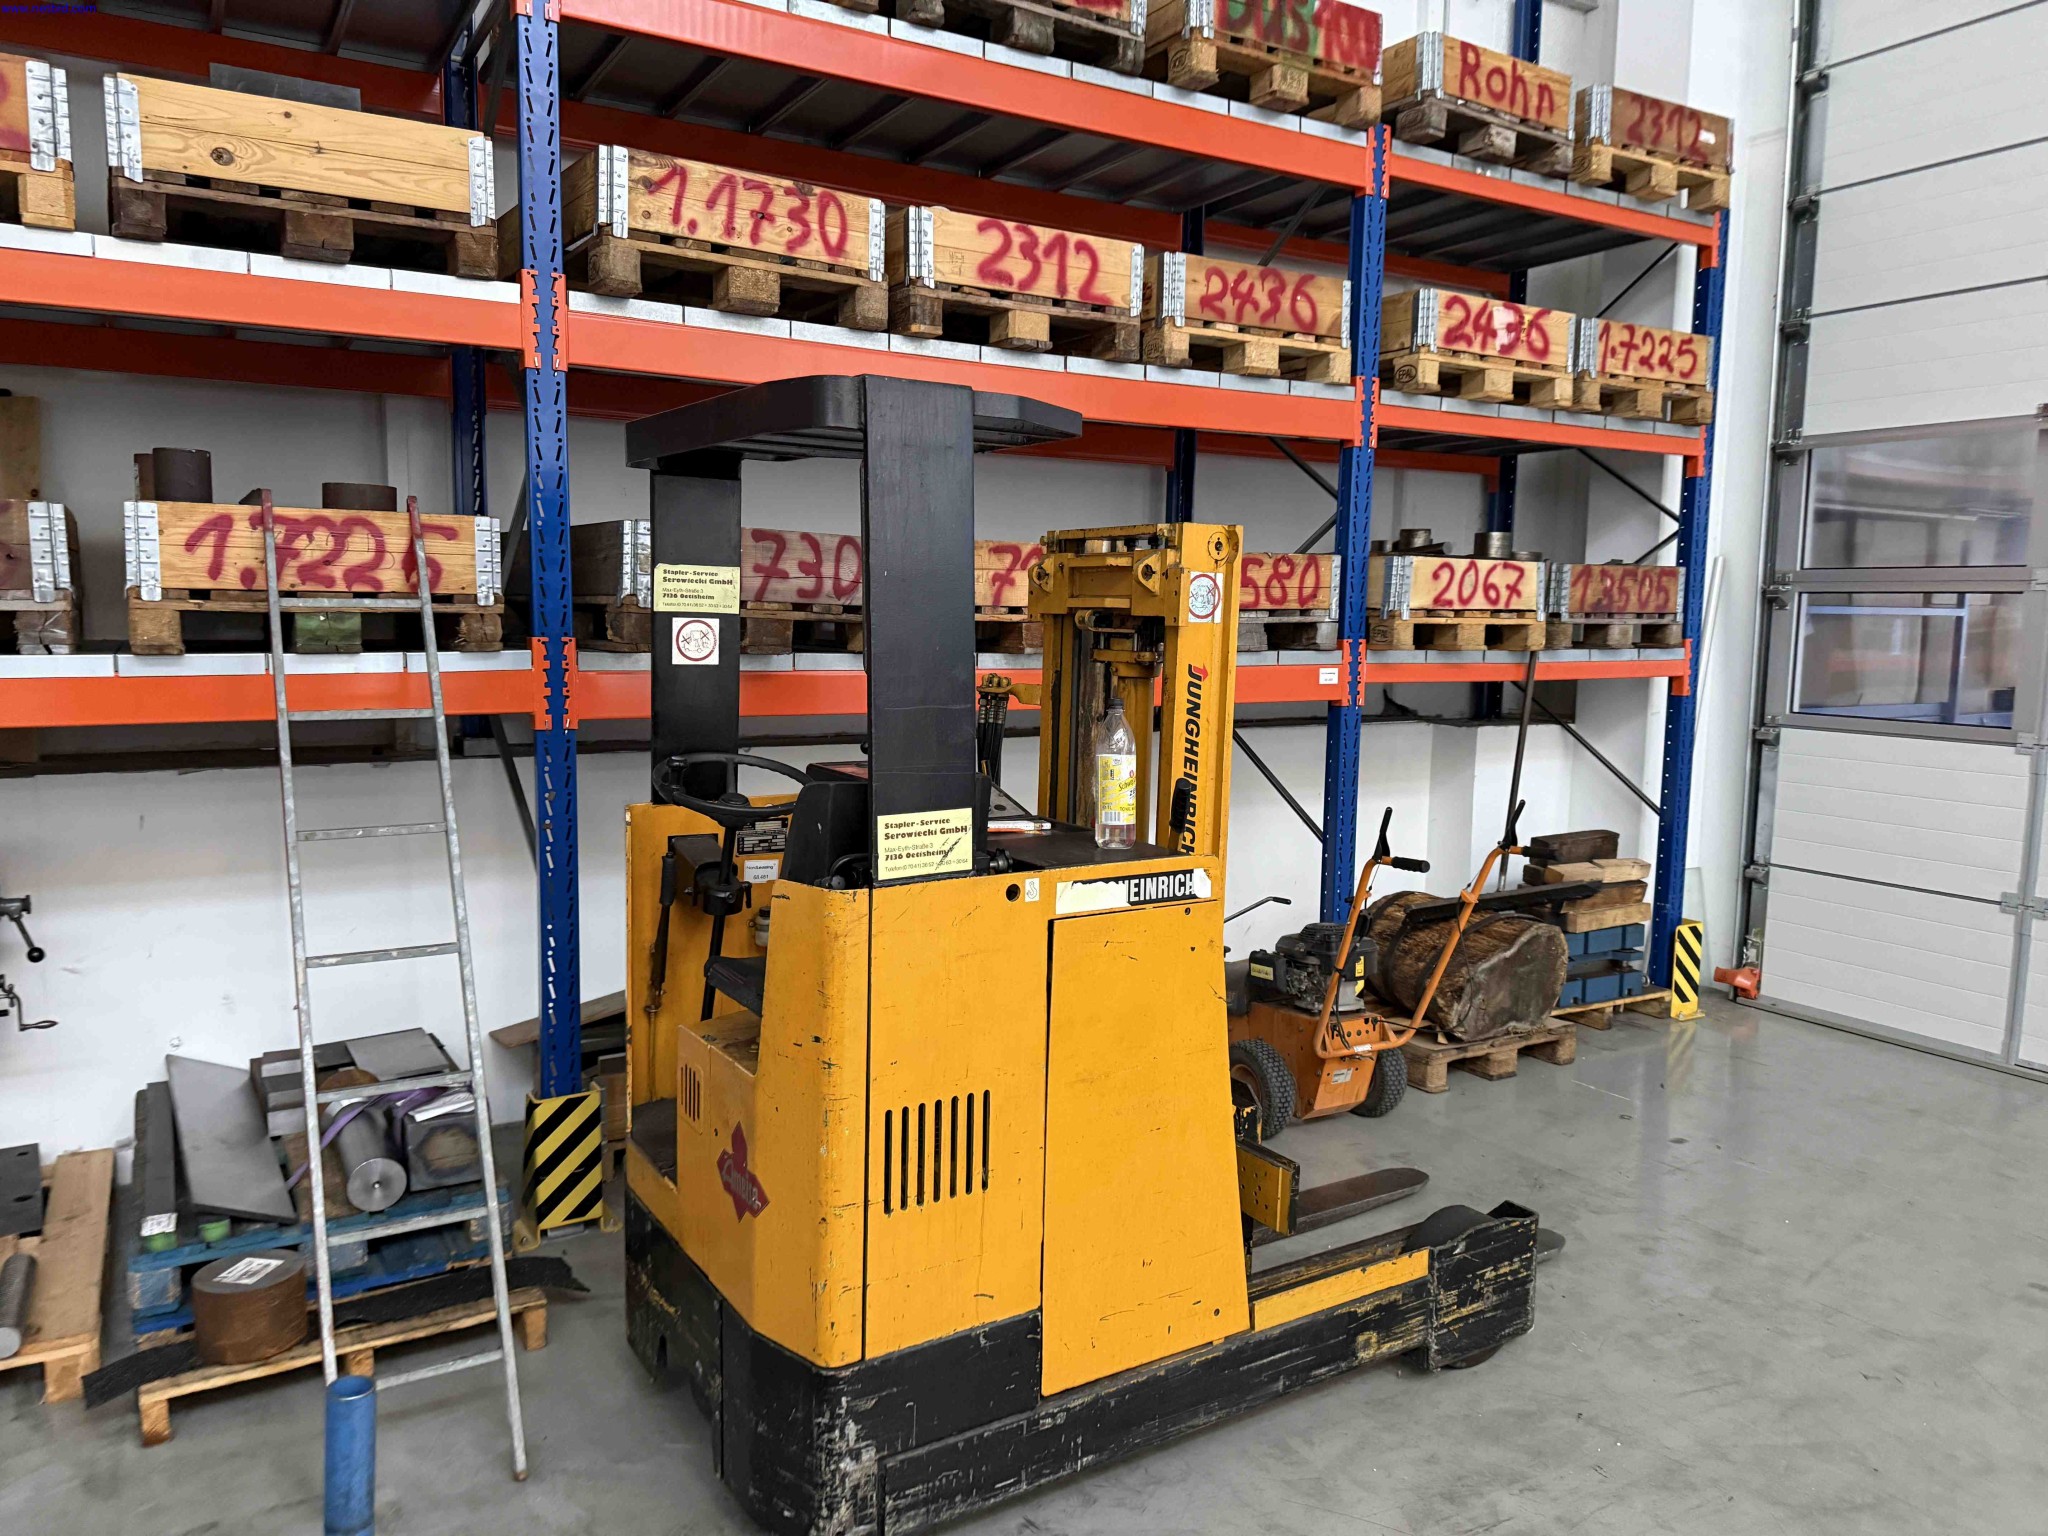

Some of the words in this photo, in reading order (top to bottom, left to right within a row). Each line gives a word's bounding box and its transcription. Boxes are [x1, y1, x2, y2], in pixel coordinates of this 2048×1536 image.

[647, 165, 848, 260] 1.1730
[977, 218, 1114, 305] 2312
[1199, 266, 1318, 332] 2436
[1443, 295, 1554, 360] 2436
[1598, 320, 1698, 379] 1.7225
[1432, 559, 1525, 608] 2067
[884, 829, 937, 841] Serowiecki
[939, 825, 968, 835] GmbH
